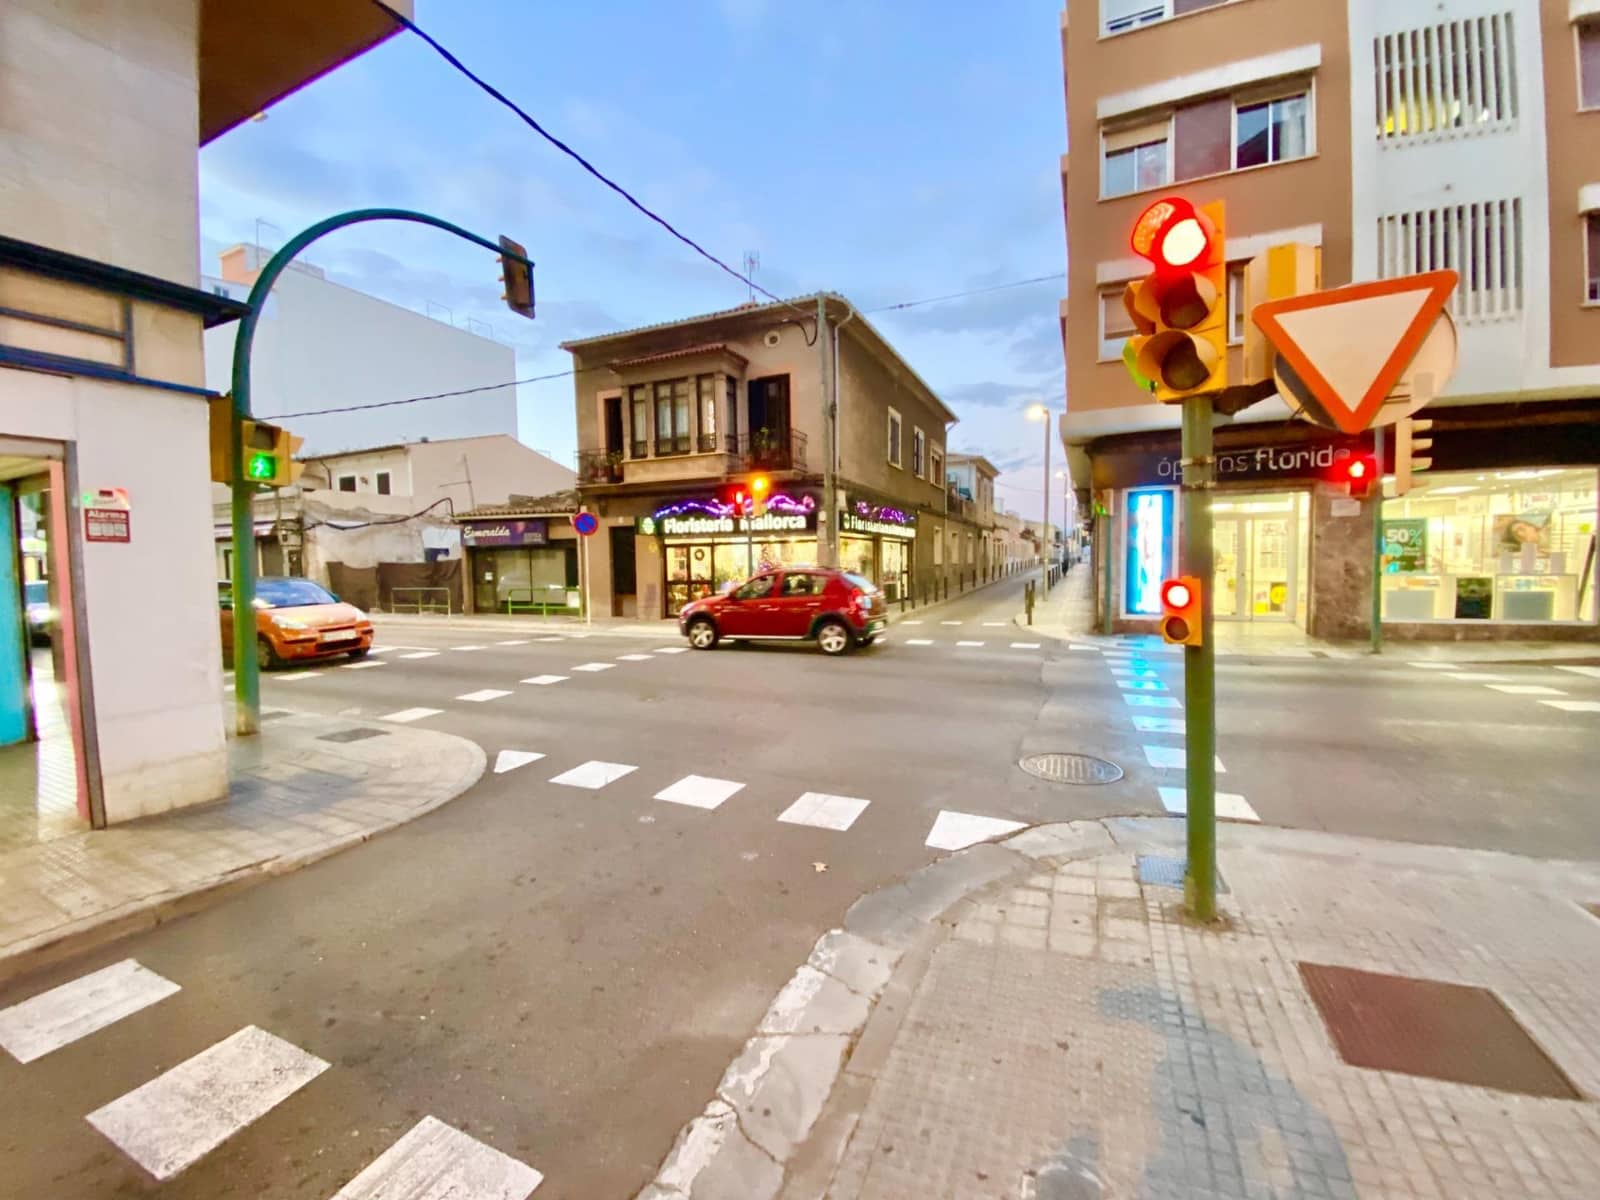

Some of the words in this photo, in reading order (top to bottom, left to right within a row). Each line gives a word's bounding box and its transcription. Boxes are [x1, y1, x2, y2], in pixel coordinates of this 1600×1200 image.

[1158, 456, 1250, 481] ópos
[463, 525, 511, 538] Esmeralda
[664, 515, 734, 533] Floristería
[1386, 529, 1423, 545] 50%
